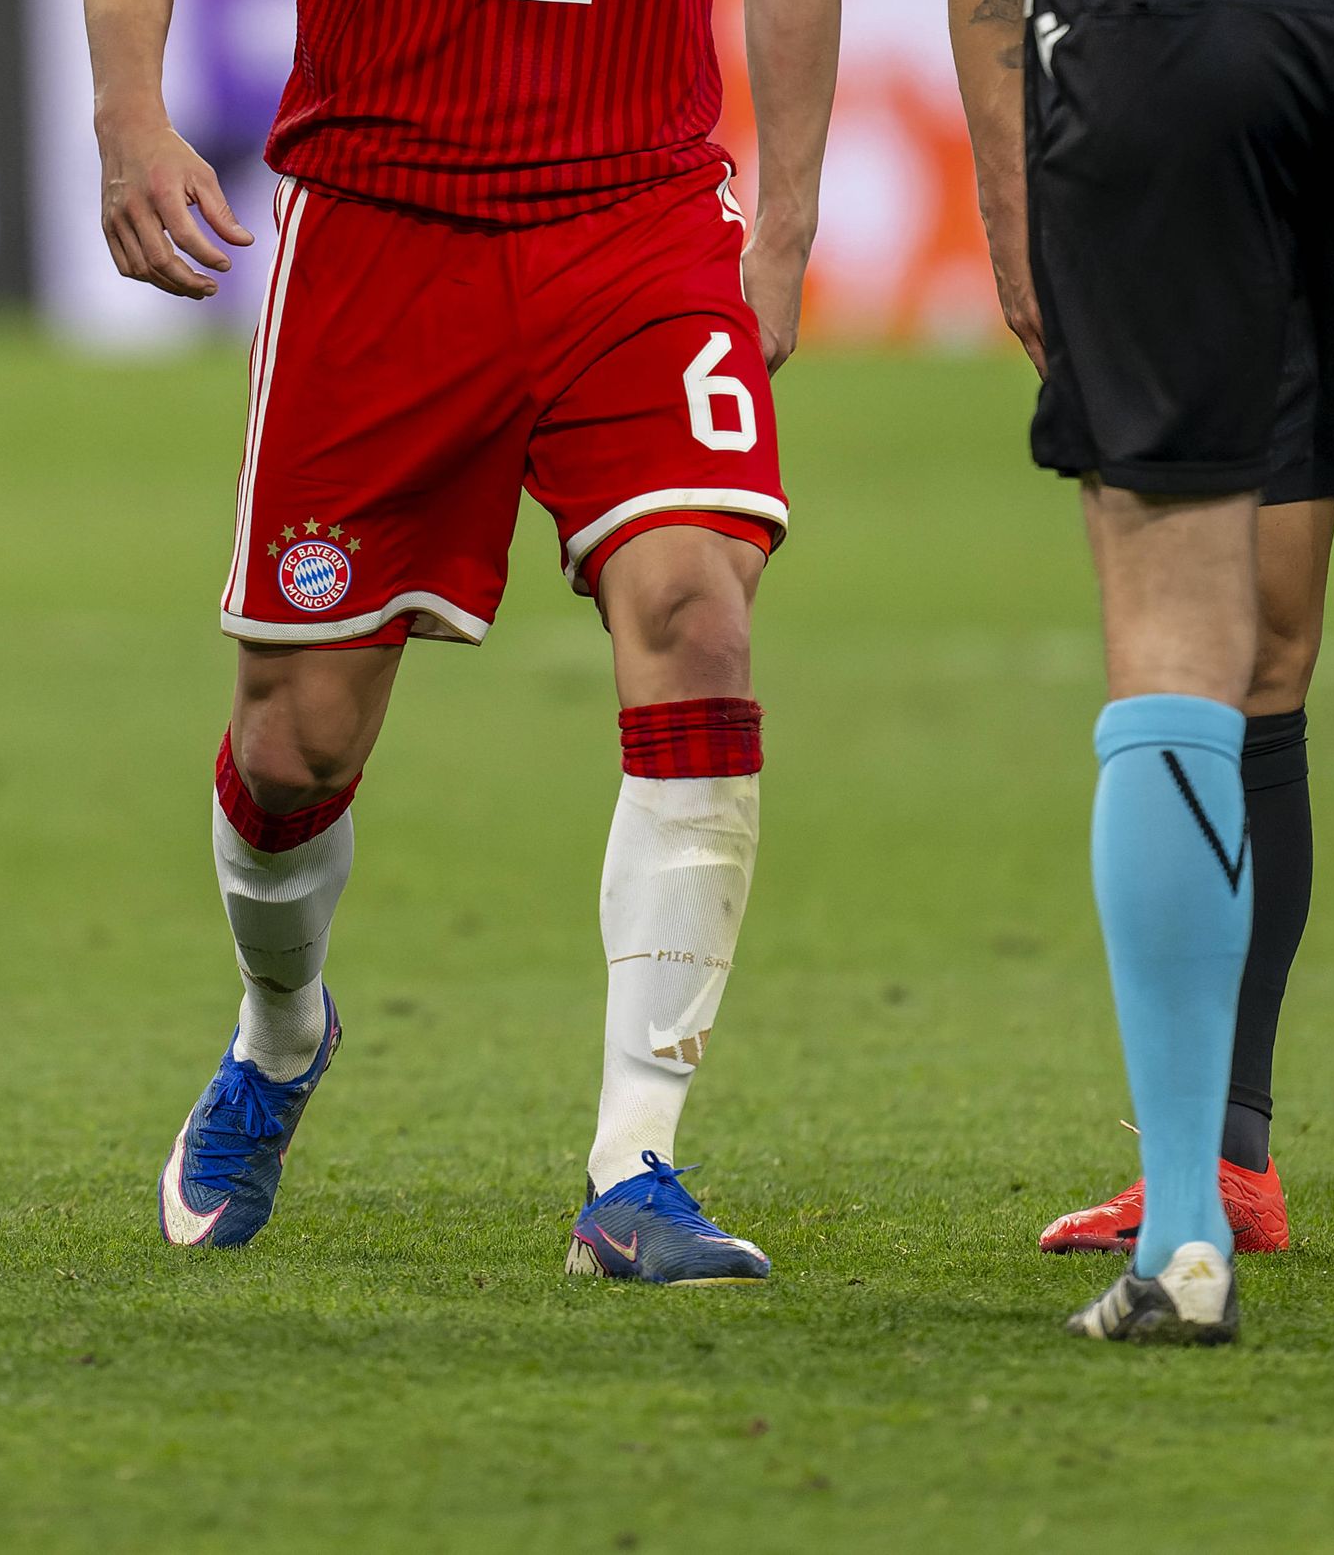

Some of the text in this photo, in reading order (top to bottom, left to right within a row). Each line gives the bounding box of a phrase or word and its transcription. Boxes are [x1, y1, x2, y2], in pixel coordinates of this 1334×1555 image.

[683, 331, 758, 453] 6
[284, 545, 345, 572] FC BAYERN
[657, 949, 695, 965] MIR
